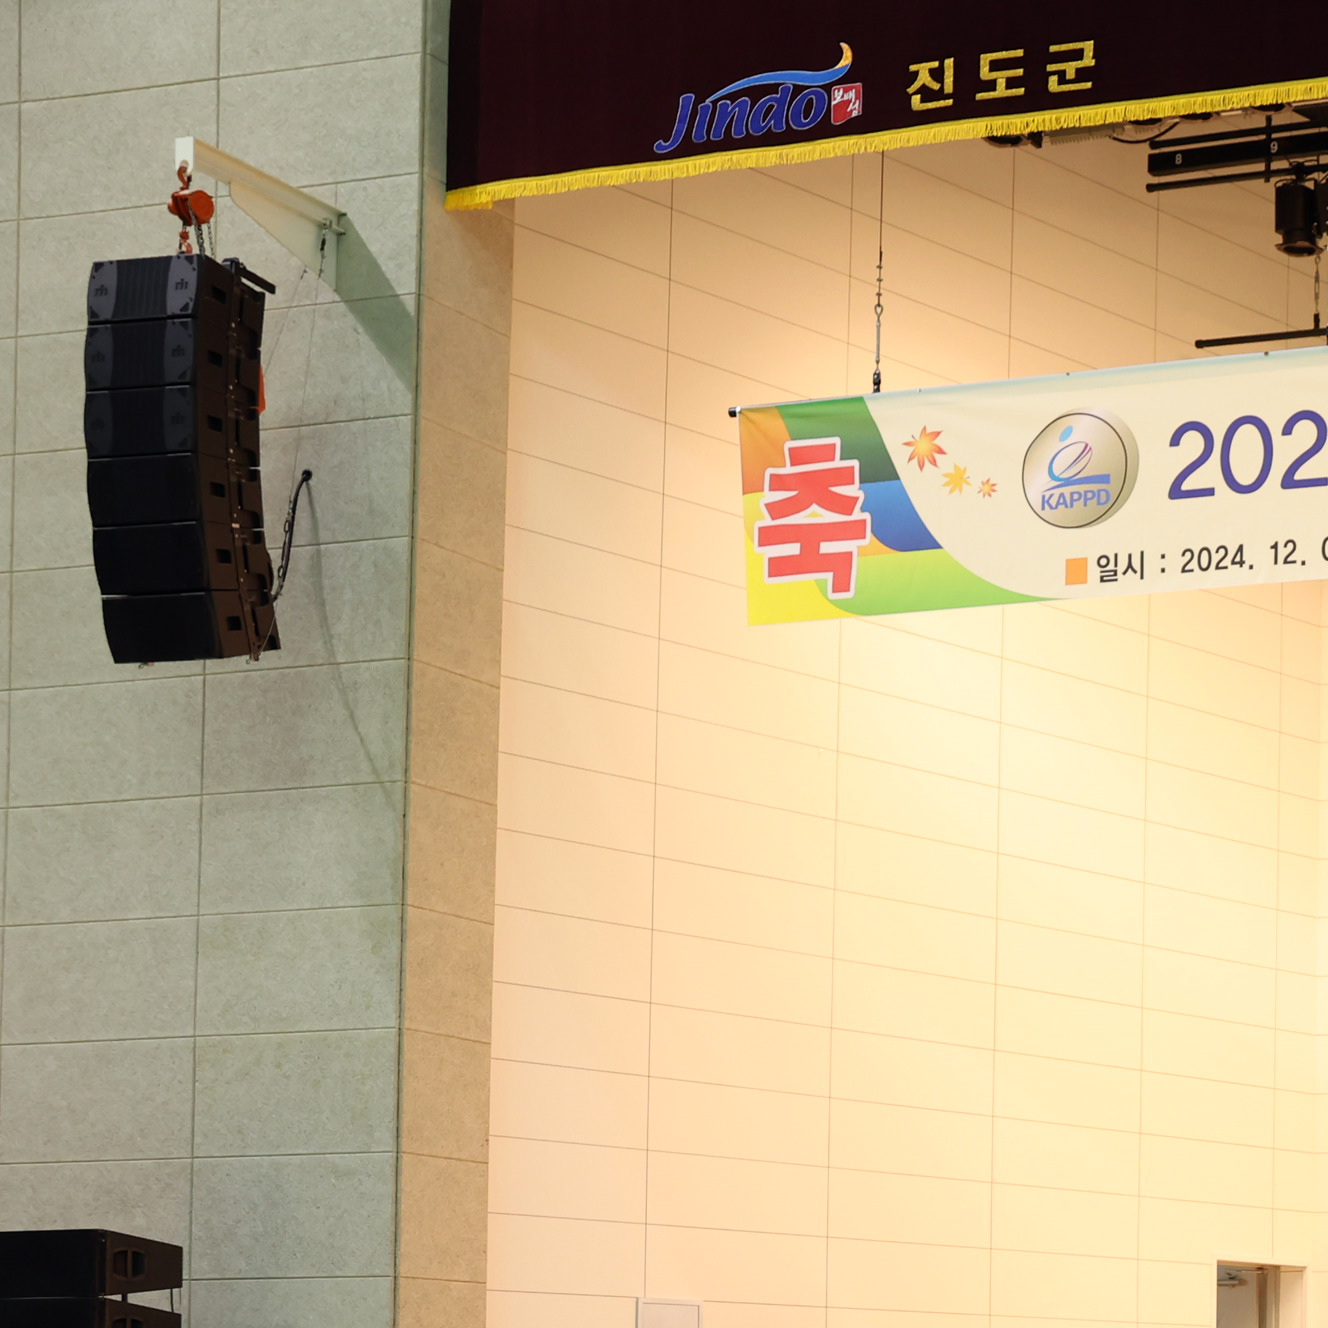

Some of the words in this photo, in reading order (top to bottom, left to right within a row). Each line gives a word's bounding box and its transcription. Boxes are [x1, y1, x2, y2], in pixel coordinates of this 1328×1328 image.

[654, 82, 828, 153] Jindo
[906, 40, 1096, 113] 진도군
[1270, 141, 1279, 154] 9
[757, 440, 868, 596] 축
[1040, 487, 1111, 512] KAPPD
[1096, 549, 1147, 585] 일시
[1180, 545, 1255, 577] 2024.
[1270, 541, 1308, 568] 12.
